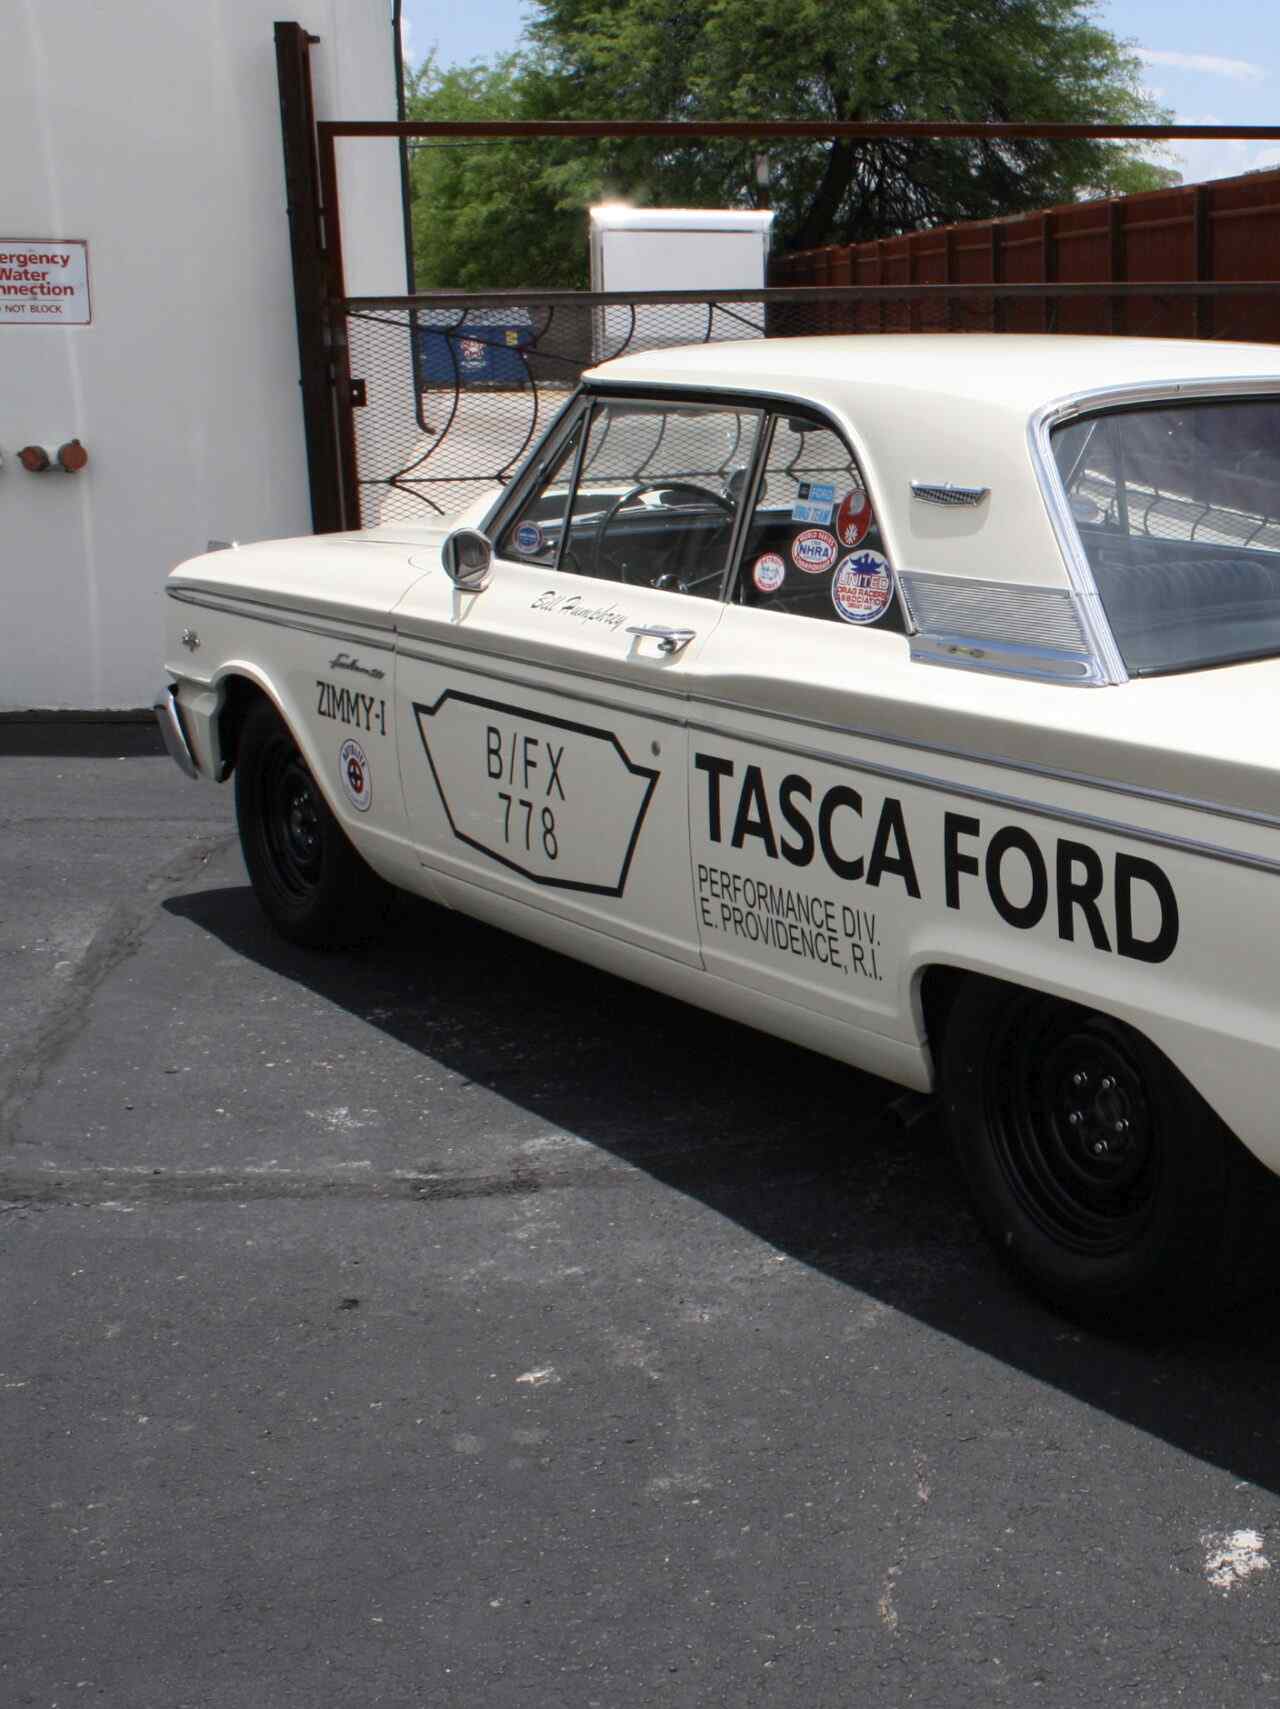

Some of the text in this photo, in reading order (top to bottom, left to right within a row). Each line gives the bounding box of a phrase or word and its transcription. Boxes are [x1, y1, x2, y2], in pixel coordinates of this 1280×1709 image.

[5, 304, 25, 313] NOT
[30, 304, 63, 314] BLOCK
[799, 544, 829, 557] NHRA
[487, 726, 565, 801] B/FX
[498, 791, 558, 860] 778
[695, 752, 1180, 965] TASCA FORD
[698, 864, 881, 947] PERFORMANCE DIV.
[700, 896, 883, 982] E. PROVIDENCE, R.I.
